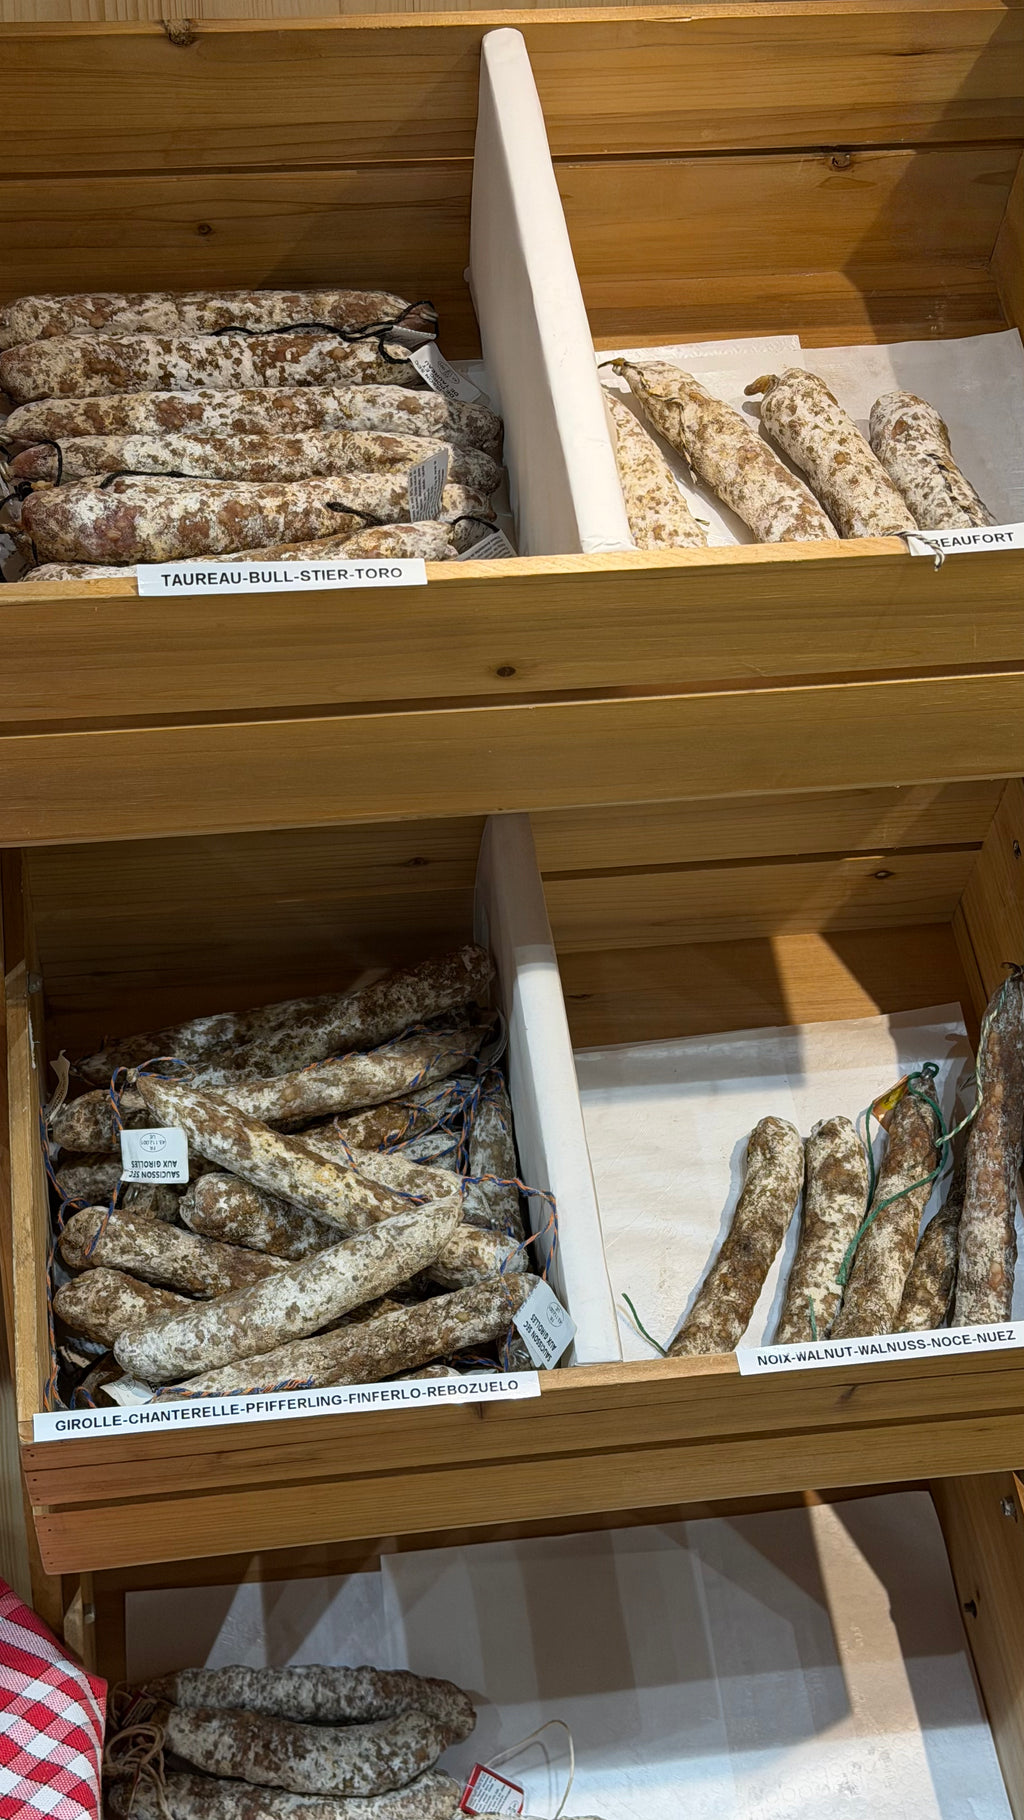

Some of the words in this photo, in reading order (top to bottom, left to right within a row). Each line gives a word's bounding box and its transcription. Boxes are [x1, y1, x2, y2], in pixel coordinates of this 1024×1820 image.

[161, 567, 403, 587] TAUREAU-BULL-STIER-TORO
[131, 1160, 161, 1168] GIROLLES
[163, 1160, 178, 1168] AUX
[141, 1171, 180, 1179] SAUCISSON
[523, 1320, 533, 1333] SEC
[530, 1313, 549, 1340] GIROLLES
[530, 1331, 552, 1362] SAUCISSON
[547, 1337, 557, 1351] AUX
[757, 1330, 1016, 1367] NOIX-WALNUT-WALNUSS-NOCE-NUEZ
[55, 1380, 519, 1432] GIROLLE-CHANTERELLE-PFIFFERLING-FINFERLO-REBOZUELO
